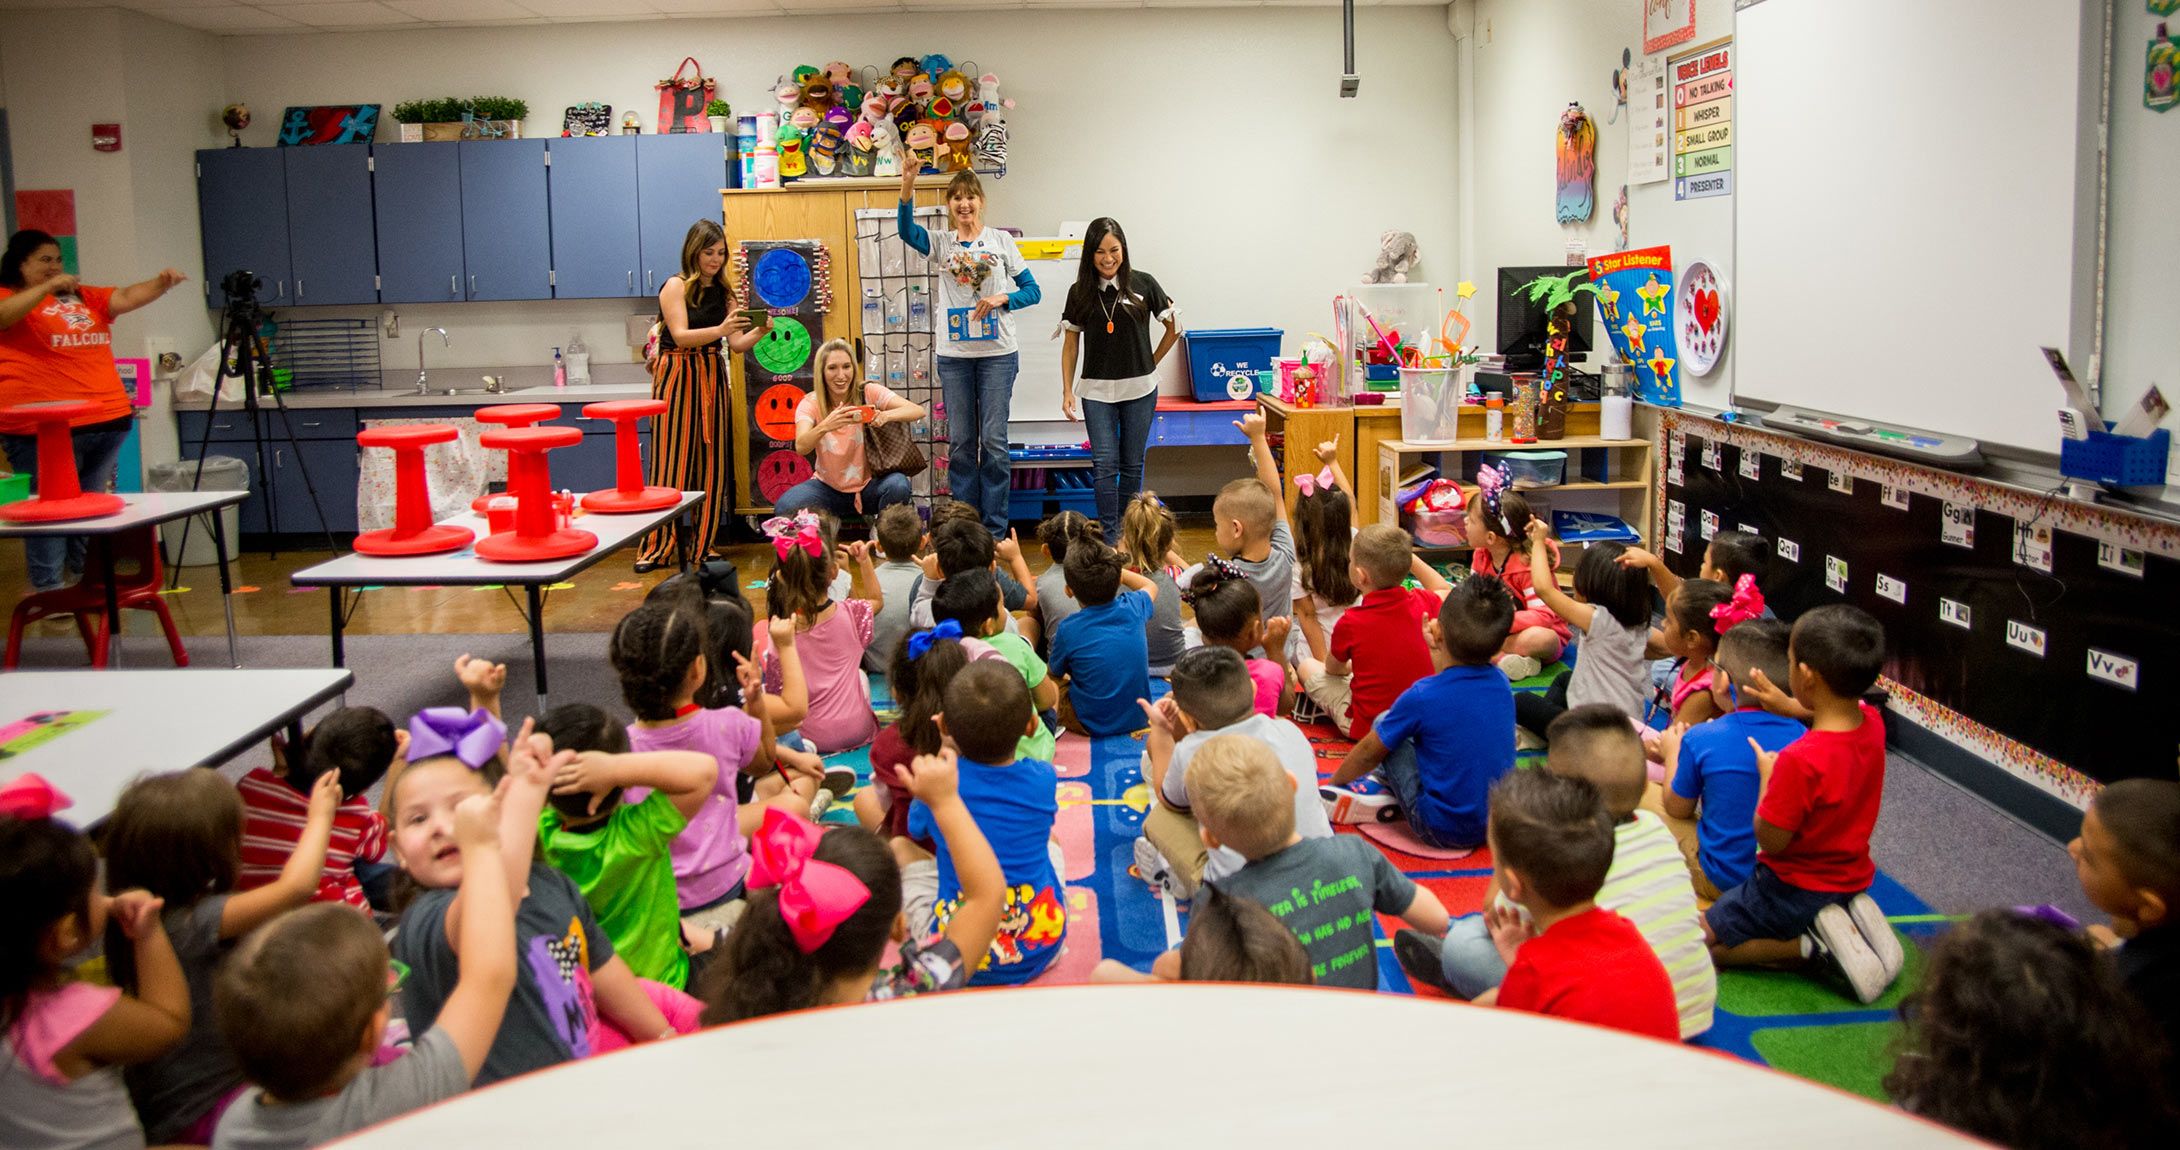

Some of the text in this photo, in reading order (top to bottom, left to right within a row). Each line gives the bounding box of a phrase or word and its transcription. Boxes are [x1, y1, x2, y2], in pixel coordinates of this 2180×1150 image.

[1677, 60, 1699, 81] VOICE
[1700, 51, 1729, 75] LEVELS
[1690, 87, 1698, 99] NO
[1700, 79, 1725, 96] TALKING
[673, 87, 704, 132] P
[1694, 106, 1720, 121] WHISPER
[1677, 127, 1729, 151] 2 SMALL GROUP
[852, 155, 868, 166] Vv
[953, 152, 968, 165] Yy
[1677, 154, 1720, 174] 3 NORMAL
[1677, 178, 1724, 197] 4 PRESENTER
[1594, 254, 1663, 275] 5 Star Listener
[1829, 472, 1840, 486] Ee
[1702, 511, 1712, 526] Oo
[1943, 502, 1960, 524] Gg
[1779, 540, 1791, 559] Qq
[2100, 543, 2115, 563] Ii
[1827, 558, 1837, 572] Rr
[1877, 576, 1889, 592] Ss
[1941, 600, 1952, 617] Tt
[2009, 622, 2028, 644] Uu
[2090, 651, 2114, 674] Vv
[1314, 923, 1334, 940] HAS
[1313, 963, 1327, 977] RE
